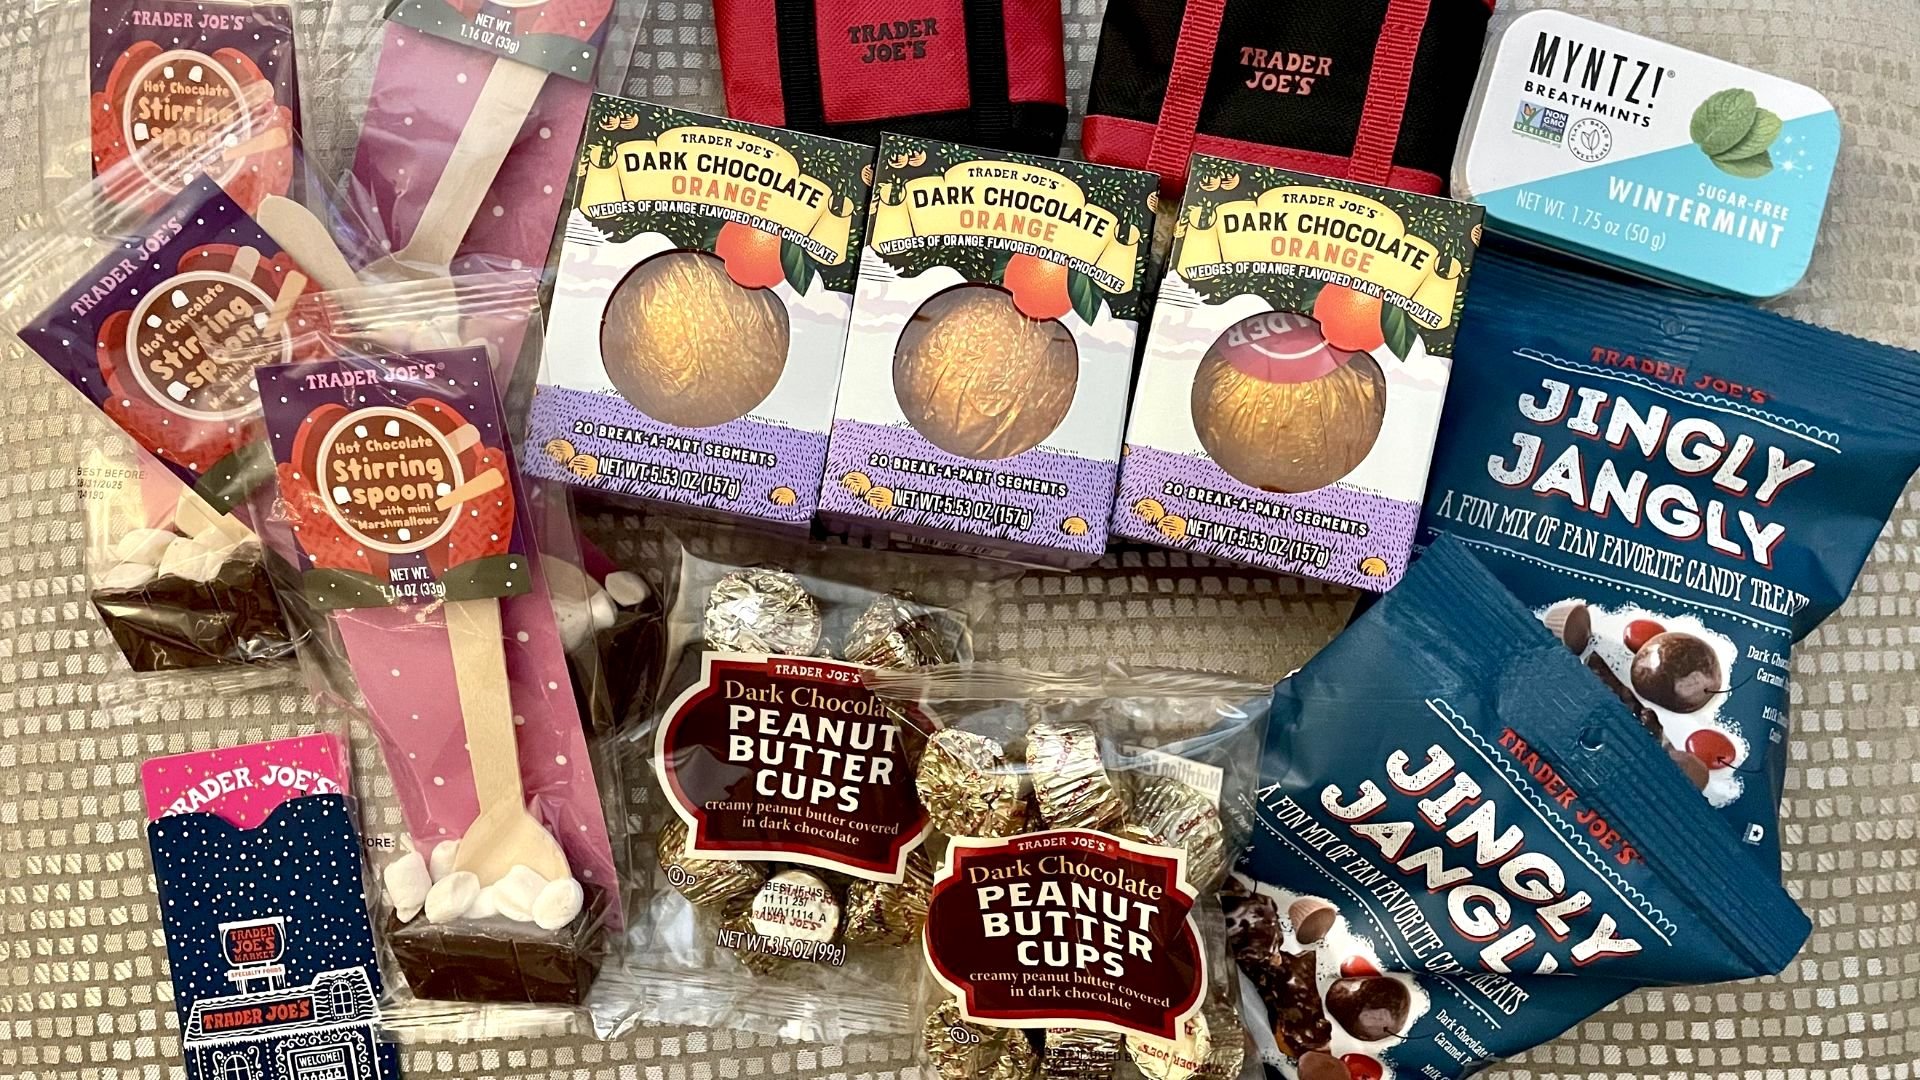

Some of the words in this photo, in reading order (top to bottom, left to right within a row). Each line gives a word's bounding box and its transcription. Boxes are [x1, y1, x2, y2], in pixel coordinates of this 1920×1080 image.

[132, 10, 193, 28] TRADER
[199, 15, 245, 30] JOE'S
[475, 13, 495, 28] NET
[496, 19, 512, 34] WT.
[847, 18, 938, 44] TRADER
[460, 25, 479, 41] 1.16
[480, 31, 494, 45] OZ
[495, 35, 520, 54] (33g)
[861, 41, 927, 64] JOE'S
[1239, 46, 1333, 76] TRADER
[1529, 31, 1664, 109] MYNTZ!
[142, 80, 166, 93] Hot
[170, 80, 230, 97] Chocolate
[1245, 71, 1316, 96] JOE'S
[1524, 80, 1651, 128] BREATHMINTS
[1545, 110, 1567, 120] NON
[1516, 123, 1561, 141] VERIFIED
[1543, 117, 1565, 128] GMO
[1570, 121, 1586, 141] PLANT
[681, 133, 733, 148] TRADER
[736, 141, 774, 159] JOE'S
[624, 151, 688, 173] DARK
[697, 153, 824, 210] CHOCOLATE
[671, 175, 772, 212] ORANGE
[968, 167, 1018, 180] TRADER
[1022, 172, 1059, 190] JOE'S
[913, 186, 975, 209] DARK
[984, 187, 1110, 238] CHOCOLATE
[1282, 193, 1335, 207] TRADER
[1339, 200, 1378, 218] JOE'S
[1608, 175, 1785, 250] WINTERMINT
[1697, 182, 1790, 222] SUGAR-FREE
[589, 201, 636, 217] WEDGES
[638, 201, 652, 212] OF
[654, 200, 697, 215] ORANGE
[699, 203, 751, 224] FLAVORED
[751, 215, 780, 235] DARK
[781, 225, 839, 265] CHOCOLATE
[959, 209, 1059, 243] ORANGE
[1515, 188, 1544, 211] NET
[1543, 195, 1567, 219] WT.
[1570, 206, 1602, 230] 1.75
[1604, 218, 1621, 237] oz
[1624, 220, 1650, 247] (50
[1650, 231, 1667, 252] g)
[1224, 212, 1289, 233] DARK
[1297, 213, 1430, 270] CHOCOLATE
[1270, 236, 1374, 274] ORANGE
[70, 258, 139, 317] TRADER
[139, 216, 183, 262] JOE'S
[1186, 263, 1234, 280] WEDGES
[1235, 262, 1251, 274] OF
[1252, 262, 1296, 276] ORANGE
[1298, 264, 1350, 287] FLAVORED
[1351, 276, 1382, 298] DARK
[1382, 289, 1442, 329] CHOCOLATE
[140, 332, 166, 358] Hot
[166, 282, 225, 335] Chocolate
[306, 369, 380, 390] TRADER
[383, 363, 436, 383] JOE'S
[1591, 346, 1688, 386] TRADER
[1694, 370, 1767, 405] JOE'S
[335, 441, 361, 455] Hot
[366, 435, 433, 452] Chocolate
[574, 421, 593, 435] 20
[598, 425, 701, 454] BREAK-A-PART
[705, 443, 777, 467] SEGMENTS
[1517, 377, 1816, 506] JINGLY
[77, 467, 102, 477] BEST
[333, 454, 444, 488] Stirring
[598, 457, 623, 476] NET
[625, 461, 648, 481] WT.
[650, 467, 679, 487] 5.53
[680, 472, 699, 489] OZ
[701, 475, 741, 501] (157g)
[869, 453, 889, 467] 20
[892, 458, 993, 486] BREAK-A-PART
[996, 475, 1068, 497] SEGMENTS
[353, 482, 434, 511] spoon
[378, 505, 405, 516] with
[407, 503, 431, 514] mini
[1164, 482, 1184, 497] 20
[1187, 488, 1290, 520] BREAK-A-PART
[1294, 510, 1368, 537] SEGMENTS
[1486, 431, 1786, 570] JANGLY
[357, 516, 440, 531] Marshmallows
[1436, 490, 1463, 518] A
[1456, 495, 1495, 531] FUN
[1499, 506, 1535, 541] MIX
[1535, 515, 1560, 547] OF
[1558, 523, 1599, 566] FAN
[1600, 535, 1685, 586] FAVORITE
[1685, 560, 1748, 602] CANDY
[389, 568, 409, 581] NET
[410, 566, 430, 579] WT.
[404, 583, 418, 597] OZ
[420, 581, 447, 597] (33g)
[1747, 645, 1770, 663] Dark
[775, 664, 822, 678] TRADER
[826, 669, 860, 684] JOE'S
[724, 680, 783, 704] Dark
[729, 704, 900, 753] PEANUT
[728, 734, 894, 785] BUTTER
[160, 766, 253, 818] RADER
[260, 765, 336, 796] JOE'S
[756, 768, 861, 813] CUPS
[1255, 781, 1282, 802] A
[1498, 726, 1580, 810] TRADER
[1575, 807, 1643, 866] JOE'S
[705, 799, 751, 813] creamy
[756, 802, 802, 818] peanut
[805, 807, 846, 825] butter
[848, 819, 899, 835] covered
[1266, 793, 1308, 826] FUN
[742, 816, 755, 828] in
[759, 818, 791, 831] dark
[794, 824, 860, 846] chocolate
[1017, 836, 1067, 851] TRADER
[1070, 836, 1106, 852] JOE'S
[1297, 818, 1332, 853] MIX
[1325, 841, 1349, 863] OF
[1385, 744, 1643, 967] JINGLY
[968, 860, 1032, 885] Dark
[1038, 856, 1163, 901] Chocolate
[1341, 850, 1380, 896] FAN
[976, 881, 1159, 932] PEANUT
[1372, 880, 1443, 957] FAVORITE
[229, 925, 275, 941] TRADER
[232, 937, 276, 953] JOE'S
[717, 929, 744, 948] NET
[746, 932, 769, 954] WT.
[771, 936, 790, 956] 3.5
[792, 938, 811, 959] OZ
[812, 941, 846, 967] (99g)
[982, 910, 1153, 963] BUTTER
[230, 969, 262, 979] SPECIALTY
[262, 966, 282, 974] FOODS
[234, 951, 275, 962] MARKET
[1017, 940, 1125, 978] CUPS
[969, 971, 1019, 984] creamy
[1022, 972, 1070, 986] peanut
[1073, 972, 1116, 991] butter
[1118, 983, 1170, 1008] covered
[1010, 985, 1024, 997] in
[1028, 985, 1061, 997] dark
[1064, 987, 1132, 1010] chocolate
[203, 1008, 262, 1031] TRADER
[264, 999, 311, 1022] JOE'S
[1434, 1032, 1466, 1061] Caramel
[1436, 1009, 1457, 1031] Dark
[1454, 1025, 1488, 1058] Chocolate
[298, 1050, 341, 1067] WELCOME!
